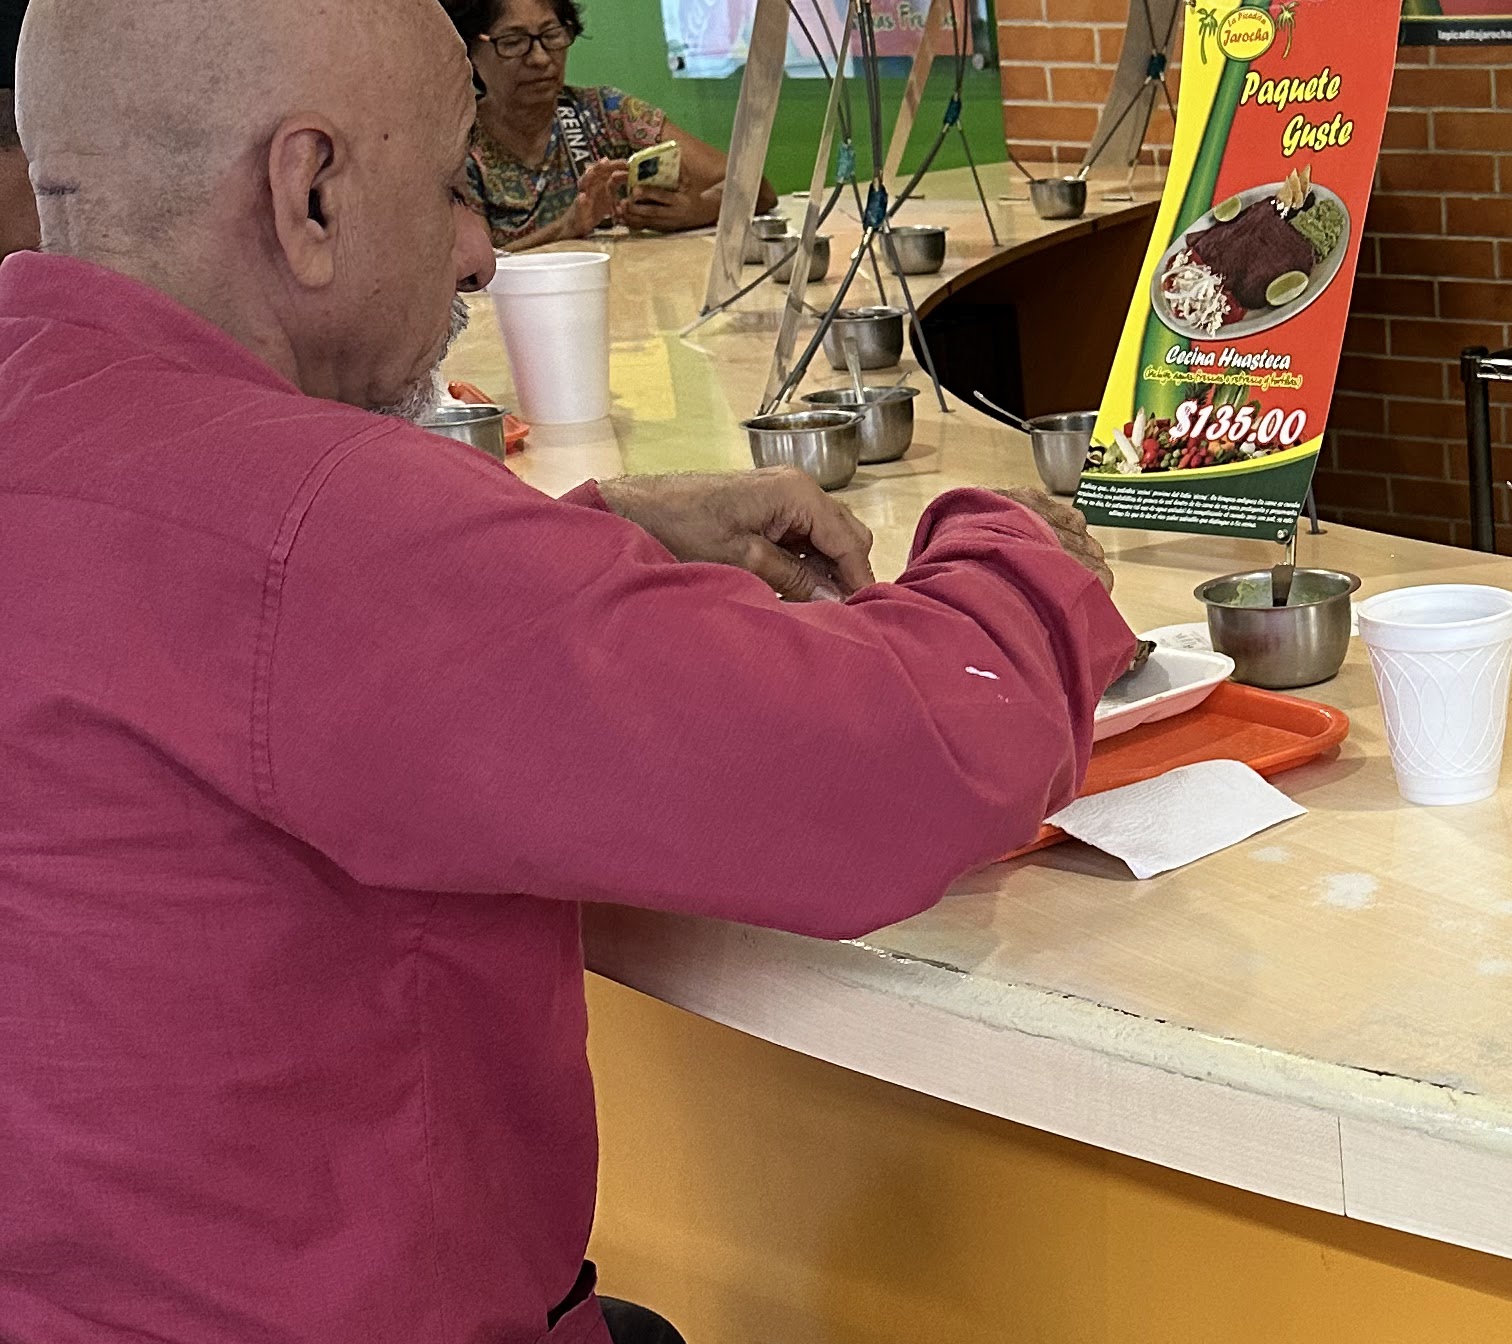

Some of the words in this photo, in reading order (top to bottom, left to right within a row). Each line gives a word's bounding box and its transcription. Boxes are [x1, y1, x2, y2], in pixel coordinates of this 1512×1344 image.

[1223, 28, 1270, 47] Jarocha
[1240, 67, 1341, 112] Paquete
[557, 106, 591, 162] REINA
[1281, 112, 1354, 157] Guste
[1168, 398, 1308, 446] $135.00
